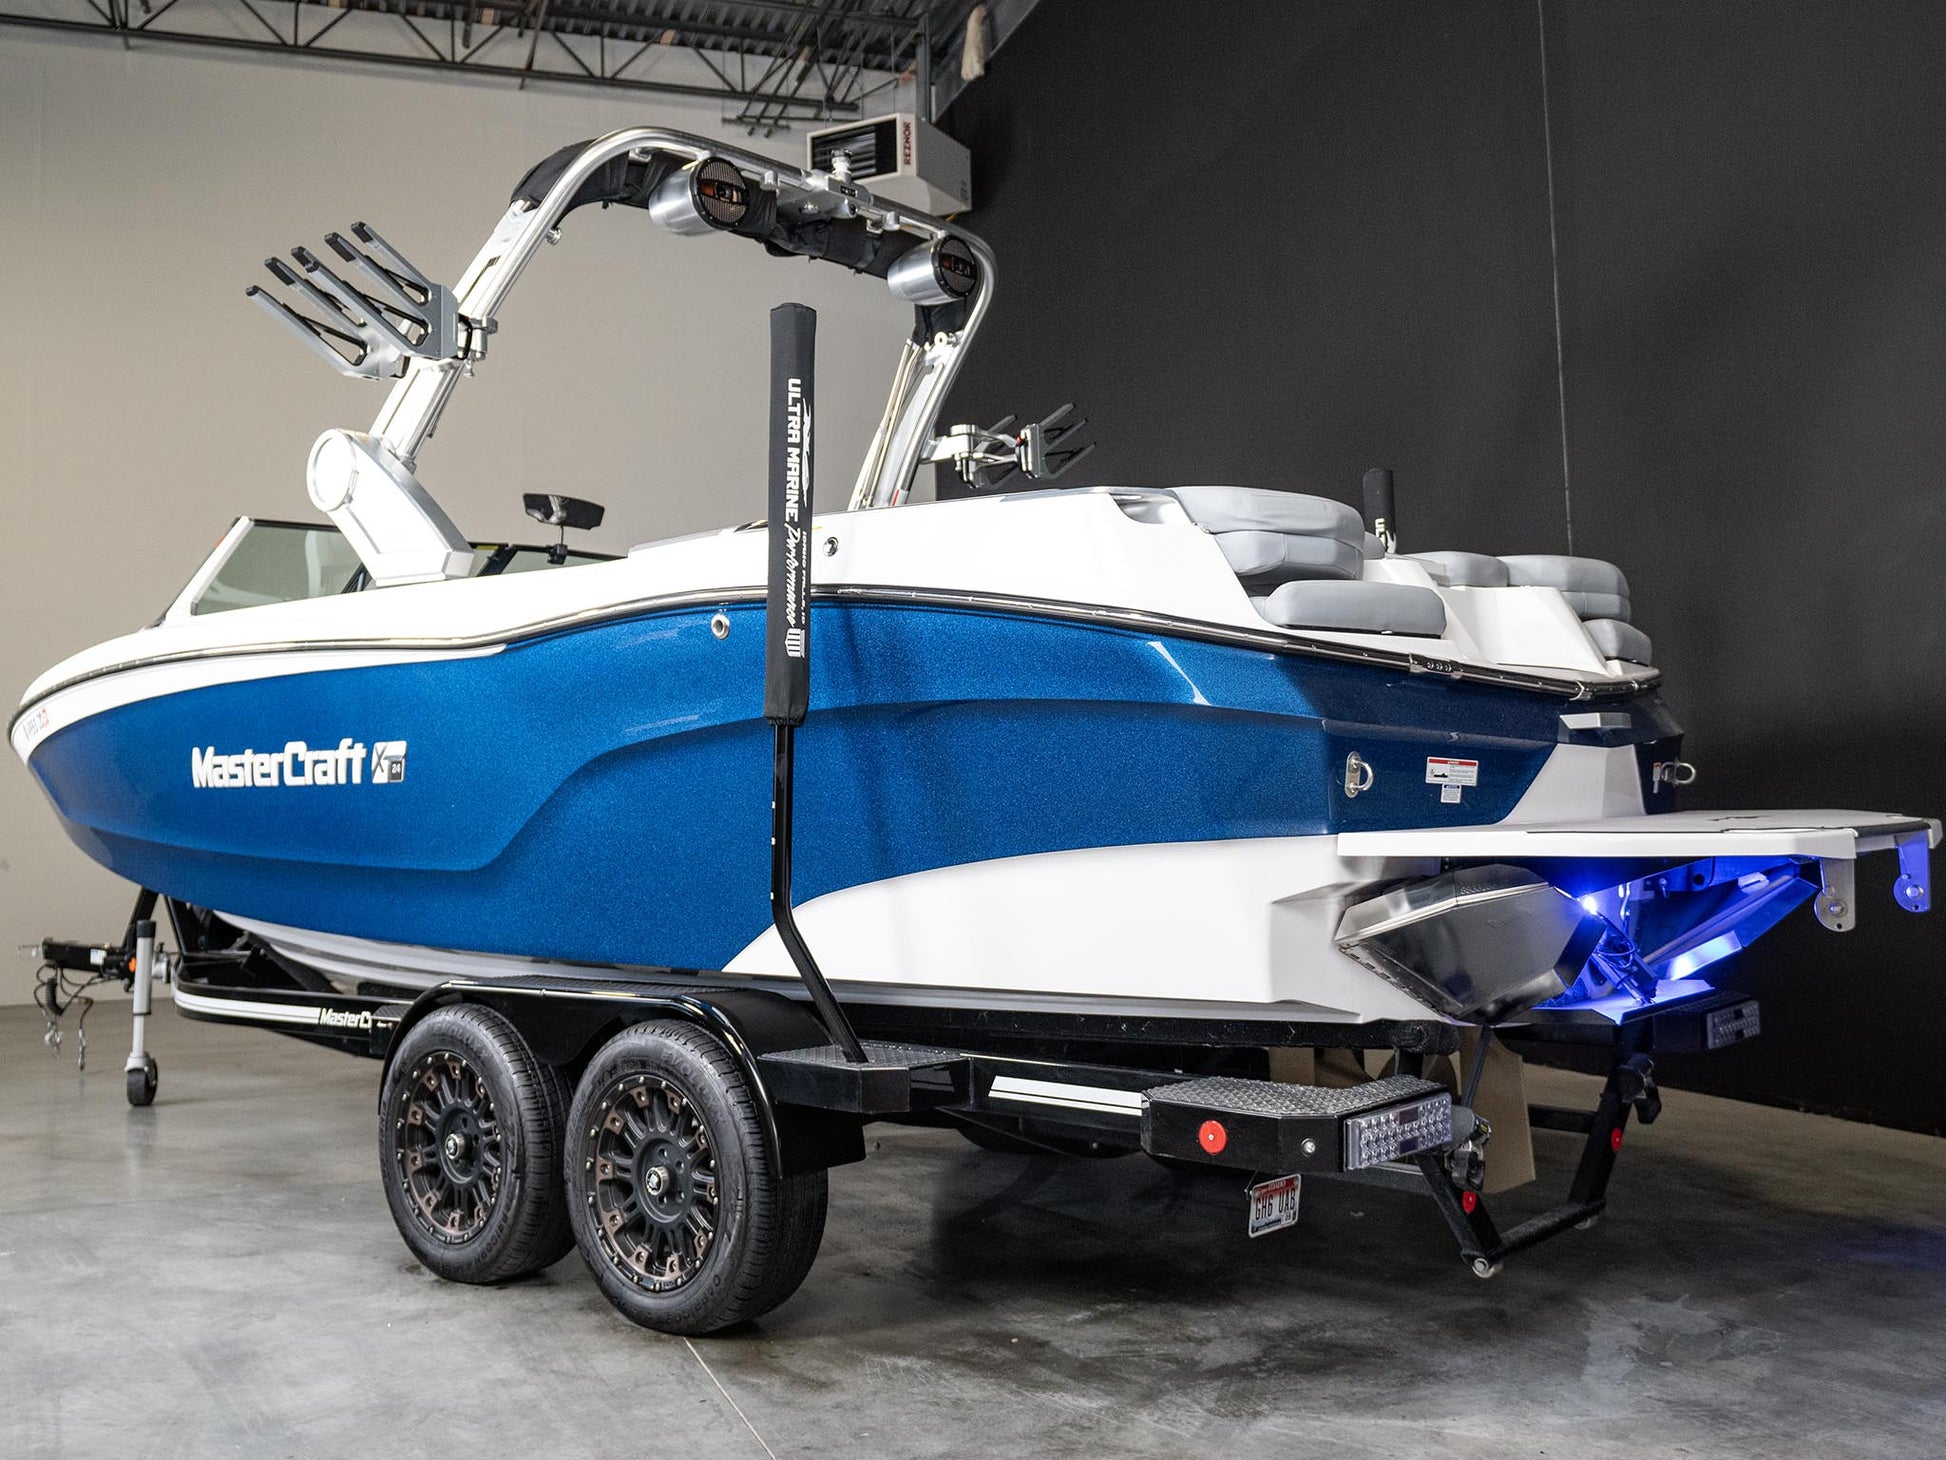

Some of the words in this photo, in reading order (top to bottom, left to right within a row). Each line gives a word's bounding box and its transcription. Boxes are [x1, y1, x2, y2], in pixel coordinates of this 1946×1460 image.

[787, 378, 801, 443] ULTRA
[785, 447, 801, 522] MARINE
[784, 523, 801, 628] Performance
[191, 737, 368, 789] MasterCraft
[1255, 1195, 1273, 1220] GH6
